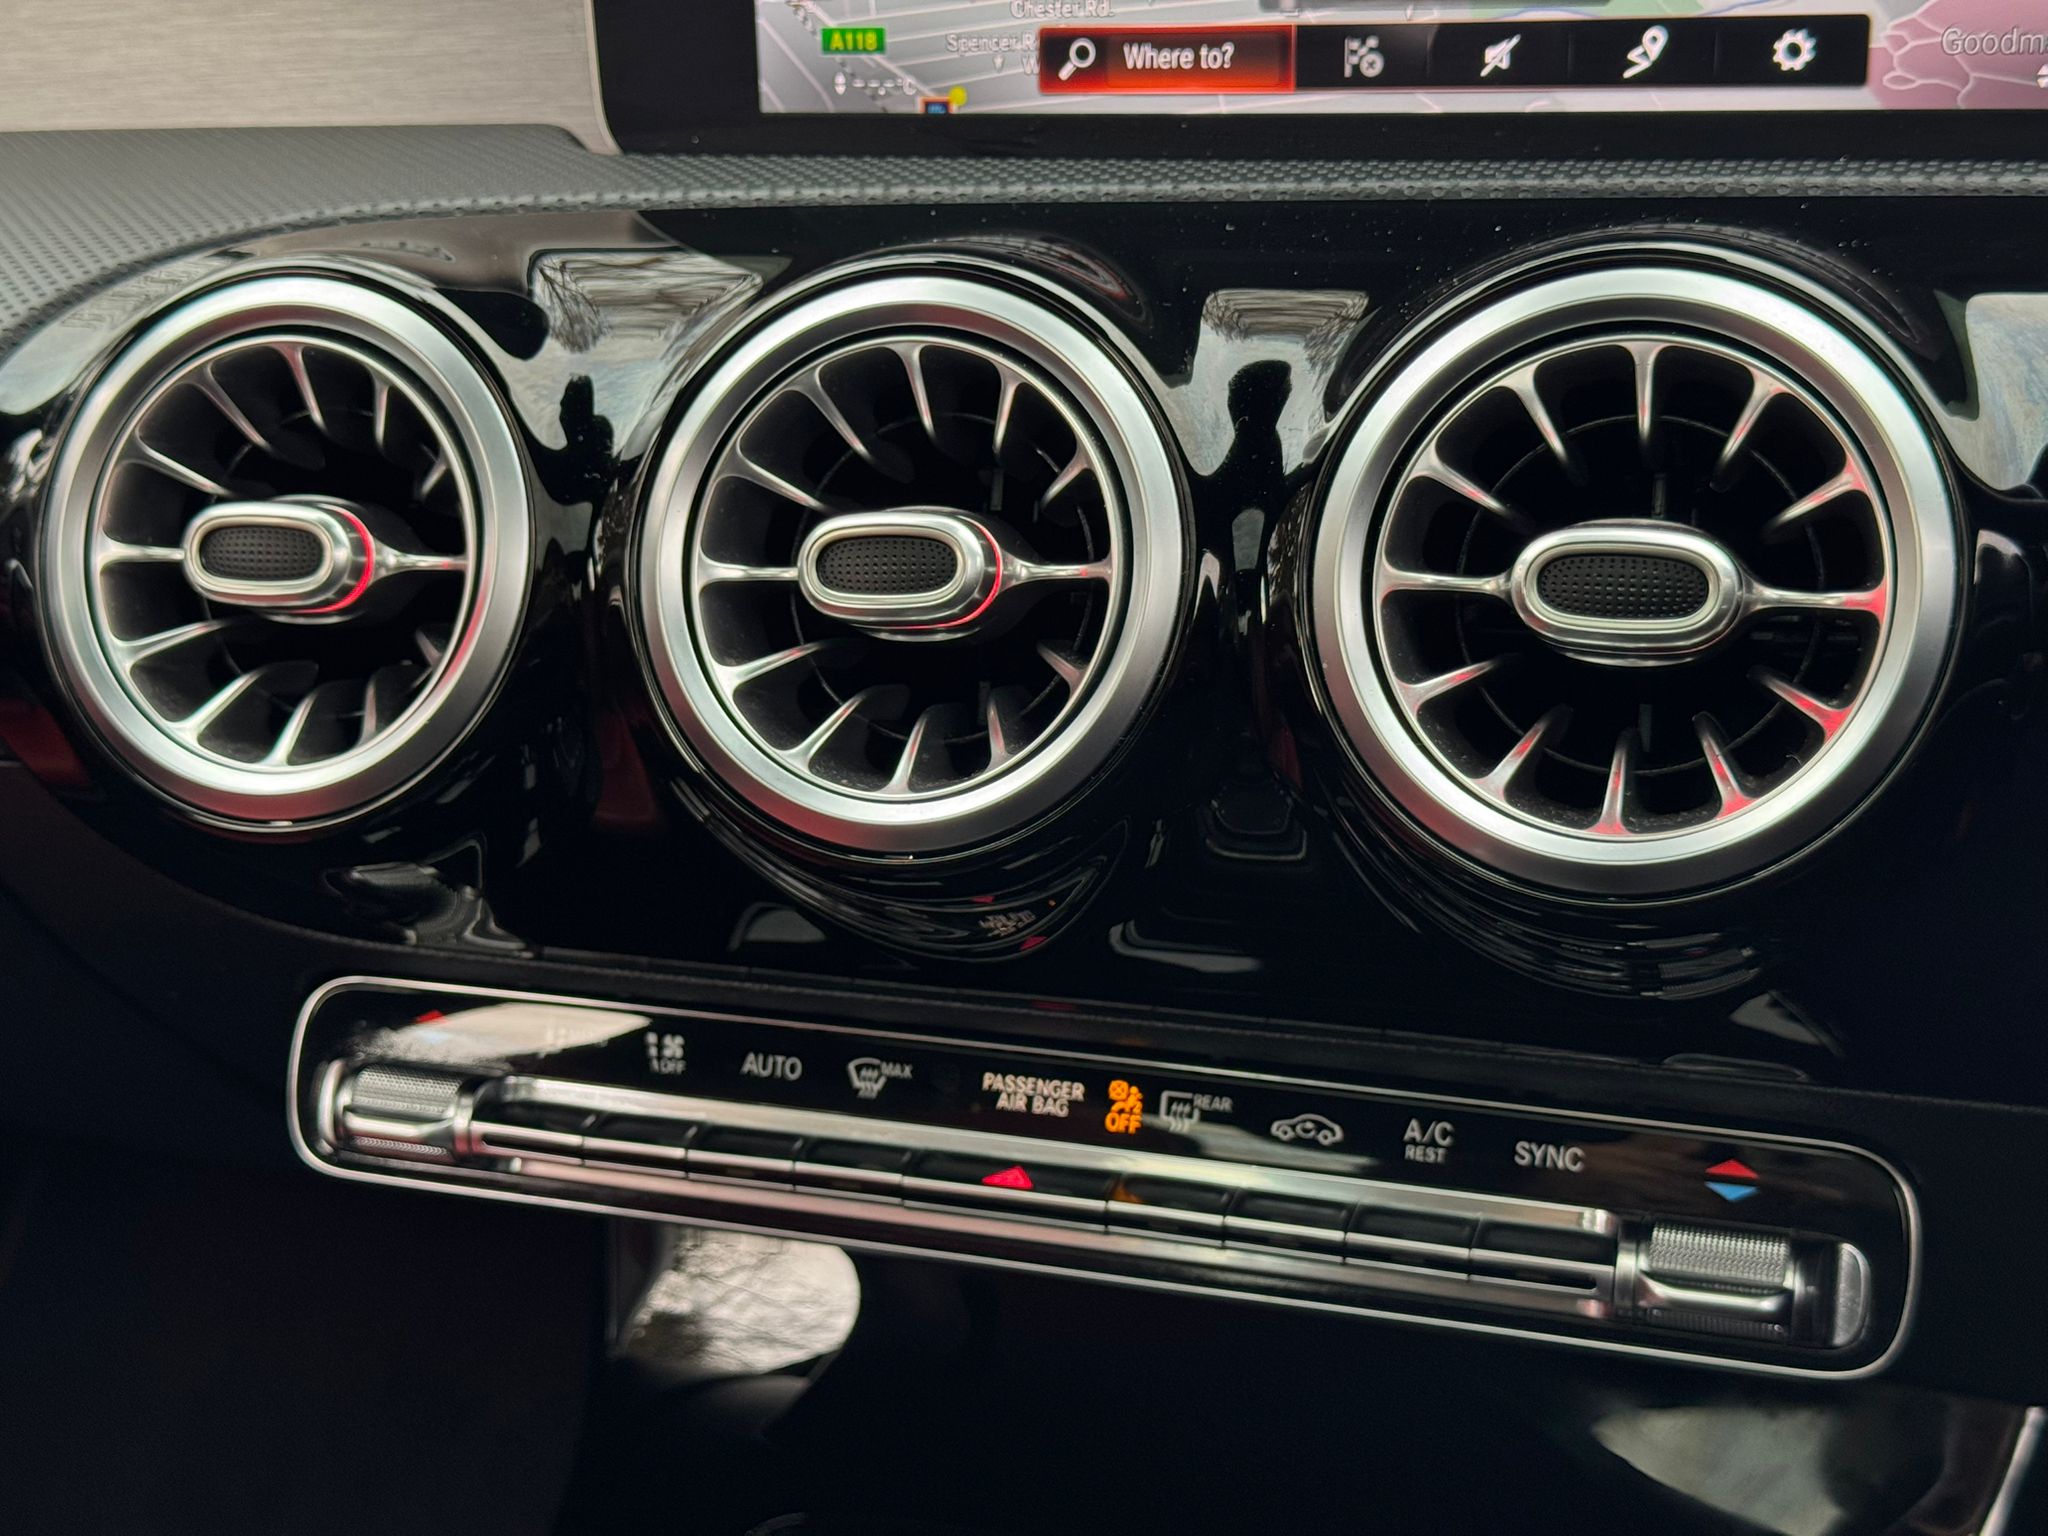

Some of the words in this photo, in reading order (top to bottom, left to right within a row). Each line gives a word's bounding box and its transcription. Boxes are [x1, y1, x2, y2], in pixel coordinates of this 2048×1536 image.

[1010, 0, 1084, 19] Chester
[946, 33, 1017, 56] Spencer
[1941, 25, 2048, 56] Goodm
[1122, 42, 1195, 69] Where
[1199, 41, 1235, 69] to?
[740, 1052, 802, 1081] AUTO
[880, 1060, 913, 1079] MAX
[982, 1072, 1085, 1101] PASSENGER
[996, 1093, 1027, 1113] AIR
[1032, 1097, 1070, 1117] BAG
[1194, 1094, 1233, 1112] REAR
[1105, 1111, 1142, 1134] OFF
[1403, 1118, 1454, 1147] A/C
[1404, 1145, 1448, 1164] REST
[1514, 1141, 1586, 1172] SYNC
